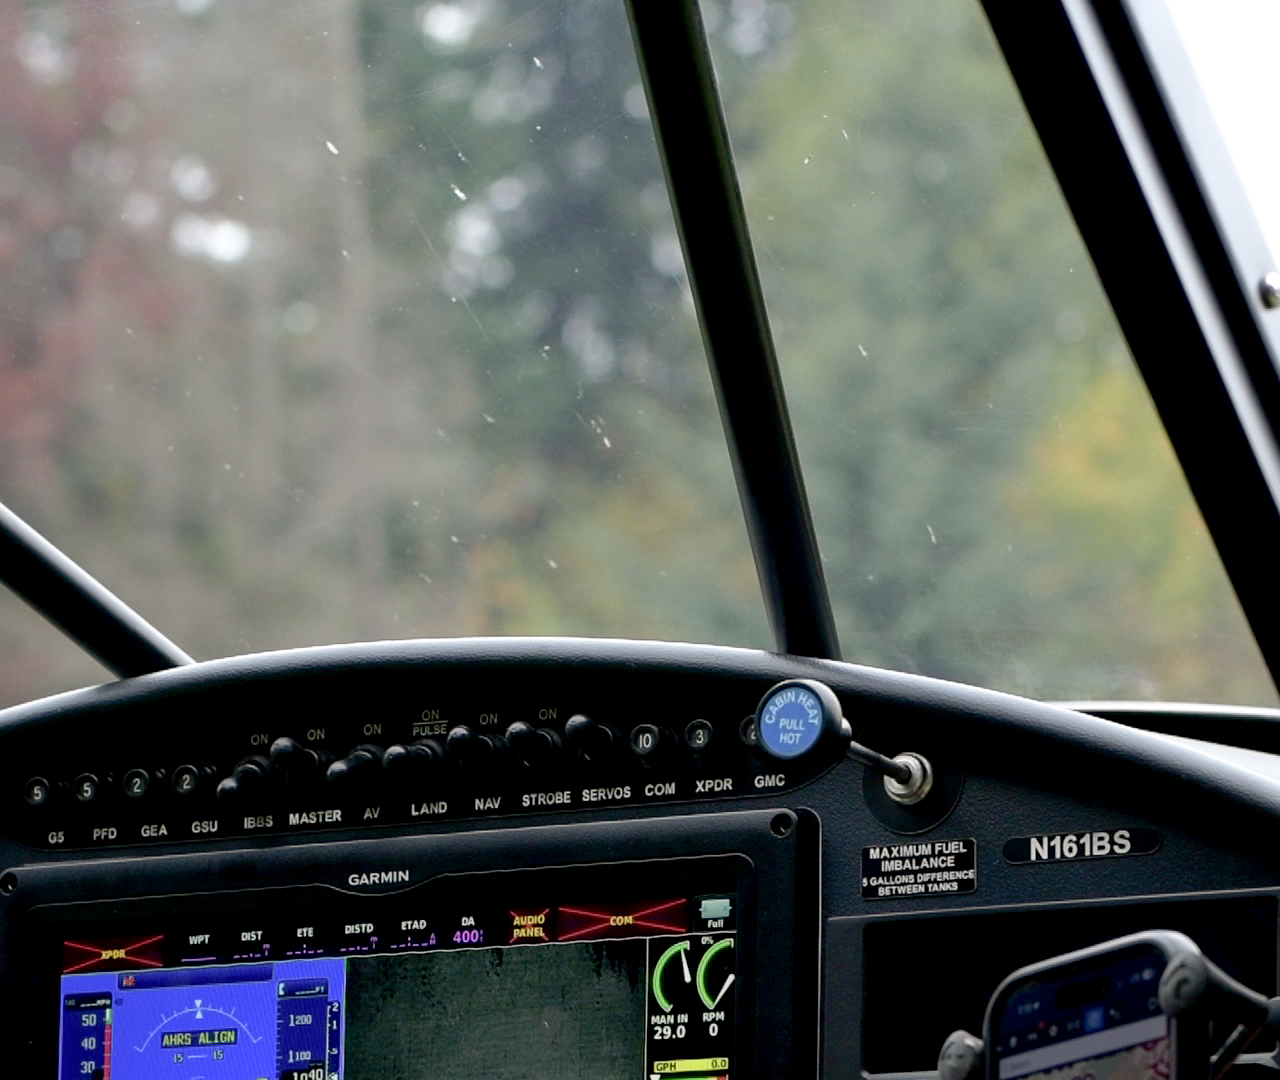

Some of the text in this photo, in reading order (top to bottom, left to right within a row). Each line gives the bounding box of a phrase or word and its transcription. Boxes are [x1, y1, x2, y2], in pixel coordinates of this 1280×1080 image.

[421, 710, 439, 720] ON
[539, 708, 557, 720] ON
[765, 691, 818, 726] CABIN HEAT
[480, 713, 498, 725] ON
[779, 718, 805, 731] PULL
[307, 729, 325, 740] ON
[363, 724, 381, 735] ON
[412, 724, 448, 736] PULSE
[251, 734, 268, 745] ON
[779, 732, 802, 744] HOT
[695, 778, 733, 793] XPDR
[754, 774, 785, 788] GMC
[582, 786, 632, 801] SERVOS
[644, 782, 676, 797] COM
[475, 797, 501, 811] NAV
[522, 790, 571, 808] STROBE
[363, 807, 380, 819] AV
[411, 801, 448, 816] LAND
[244, 815, 273, 829] IBBS
[288, 809, 342, 825] MASTER
[141, 824, 168, 837] GEA
[191, 820, 218, 833] GSU
[48, 832, 64, 844] G5
[93, 828, 117, 840] PFD
[869, 841, 967, 860] MAXIMUM FUEL
[1030, 829, 1131, 861] N161BS
[881, 856, 956, 872] IMBALANCE
[348, 869, 410, 887] GARMIN
[870, 869, 975, 887] GALLONS DIFFERENCE
[877, 881, 958, 897] BETWEEN TANKS
[401, 920, 427, 931] ETAD
[461, 916, 475, 927] DA
[513, 914, 546, 926] AUDIO
[297, 926, 315, 938] ETE
[344, 922, 374, 935] DISTD
[513, 927, 546, 939] PANEL
[188, 934, 210, 945] WPT
[241, 930, 263, 942] DIST
[82, 1014, 97, 1027] 50
[289, 1014, 312, 1027] 1200
[651, 1014, 675, 1025] MAN
[702, 1010, 725, 1022] RPM
[162, 1031, 236, 1047] AHRS ALIGN
[653, 1025, 687, 1041] 29.0
[81, 1036, 96, 1050] 40
[288, 1050, 312, 1063] 1100
[655, 1059, 727, 1072] GPH 0.0
